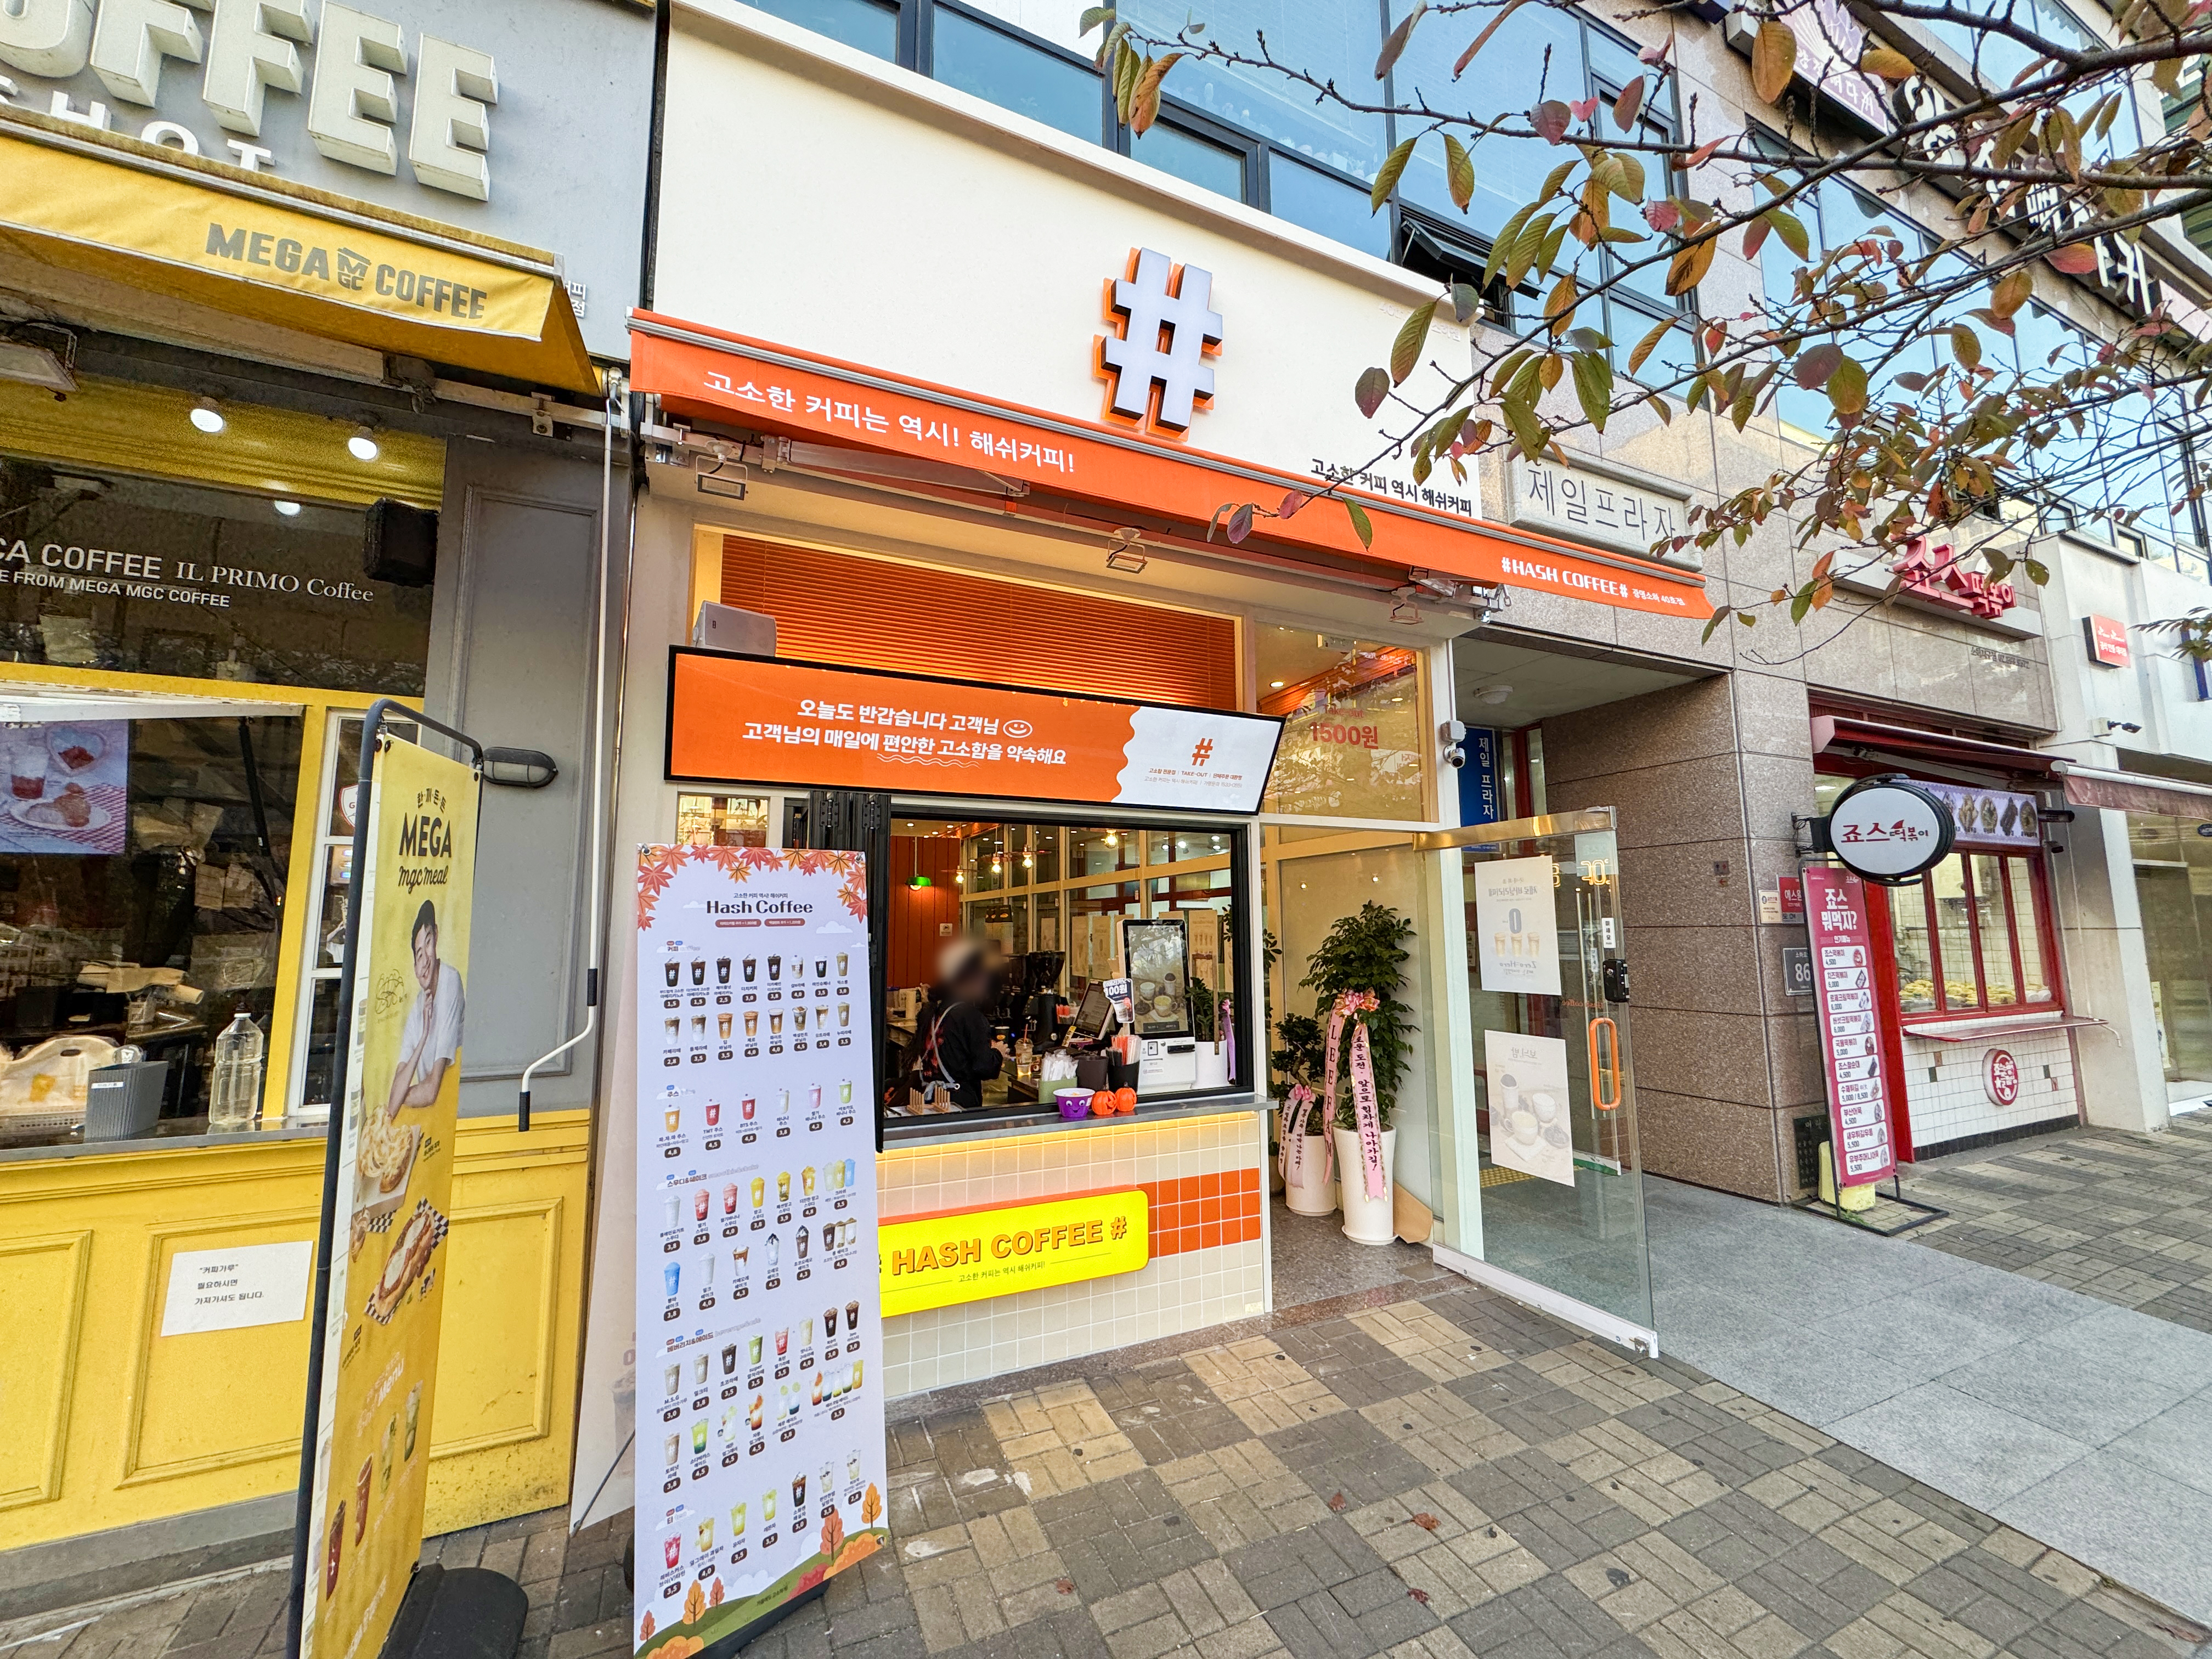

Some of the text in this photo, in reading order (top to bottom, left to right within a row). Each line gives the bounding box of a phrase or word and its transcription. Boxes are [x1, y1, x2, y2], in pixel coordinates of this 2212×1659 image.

[206, 223, 329, 280] MEGA
[375, 268, 487, 320] COFFEE
[703, 370, 1075, 473] 고소한 커피는 역시! 해쉬커피!
[1311, 458, 1472, 517] 고소한 커피 역시 해쉬커피
[1527, 467, 1676, 541] 제일프라자
[41, 543, 163, 579] COFFEE
[175, 561, 204, 582] IL
[210, 565, 300, 592] PRIMO
[306, 578, 375, 602] Coffee
[14, 571, 64, 589] FROM
[69, 577, 121, 595] MEGA
[126, 584, 164, 600] MGC
[168, 589, 230, 608] COFFEE
[797, 699, 1000, 736] 오늘도 반갑습니다 고객님
[742, 723, 1067, 766] 고객님의 매일에 편안한 고소함을 약속해요
[1310, 721, 1379, 750] 1500원
[398, 812, 452, 858] MEGA
[1841, 820, 1929, 843] 죠스떡볶이
[706, 900, 813, 914] Hash Coffee
[1824, 888, 1849, 910] 죠스
[1820, 911, 1858, 931] 뭐먹지?
[1795, 963, 1810, 982] 86
[1841, 1084, 1859, 1092] 수제튀김
[1843, 1107, 1863, 1116] 부산어묵
[891, 1238, 981, 1278] HASH
[991, 1220, 1103, 1262] COFFEE
[197, 1278, 238, 1290] 필요하시면
[958, 1261, 1045, 1283] 고소한 커피는 역시 해쉬커피!
